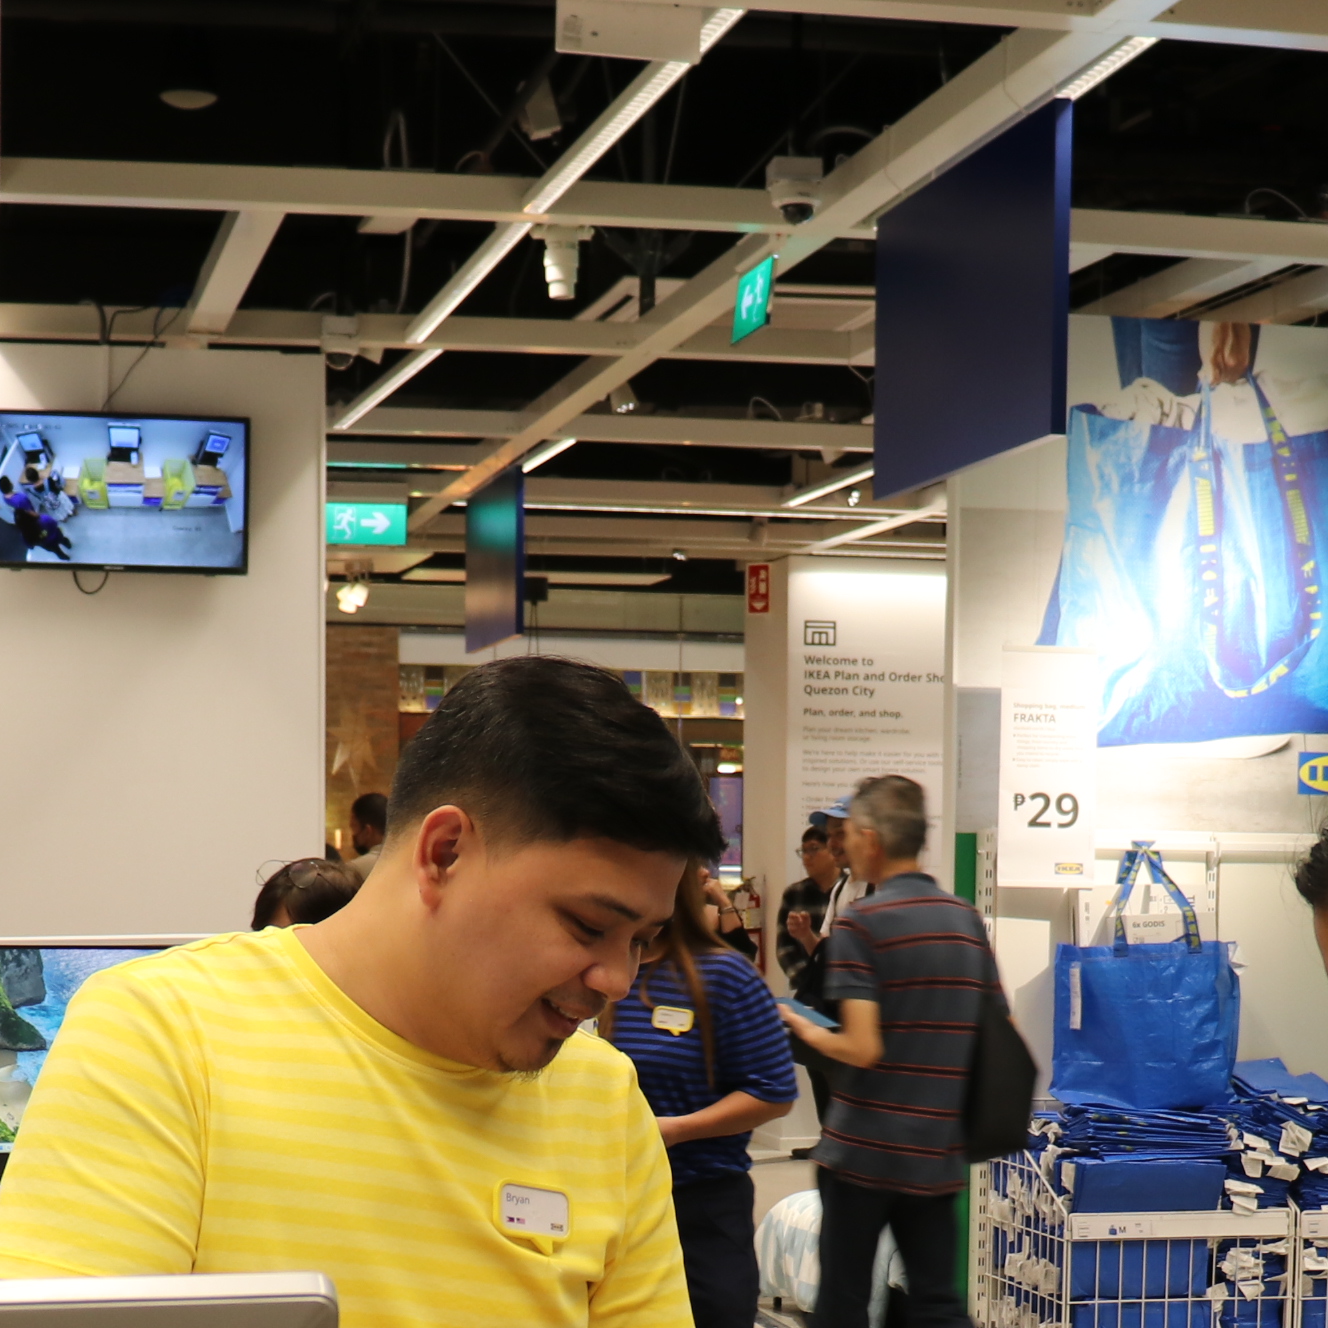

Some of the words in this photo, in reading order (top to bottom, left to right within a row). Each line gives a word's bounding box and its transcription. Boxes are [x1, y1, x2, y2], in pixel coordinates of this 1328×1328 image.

[804, 655, 858, 665] Welcome
[862, 657, 874, 666] to
[804, 670, 831, 680] IKEA
[834, 670, 860, 681] Plan
[863, 672, 885, 682] and
[888, 672, 922, 682] Order
[804, 684, 849, 697] Quezon
[852, 685, 876, 698] City
[1013, 702, 1043, 711] Shopping
[803, 708, 825, 718] Plan,
[828, 708, 856, 718] order,
[859, 708, 876, 718] and
[879, 709, 904, 720] shop.
[1013, 713, 1056, 723] FRAKTA
[1132, 921, 1141, 929] 6x
[1142, 920, 1166, 929] GODIS
[506, 1192, 530, 1205] Bryan
[1118, 1226, 1127, 1234] M
